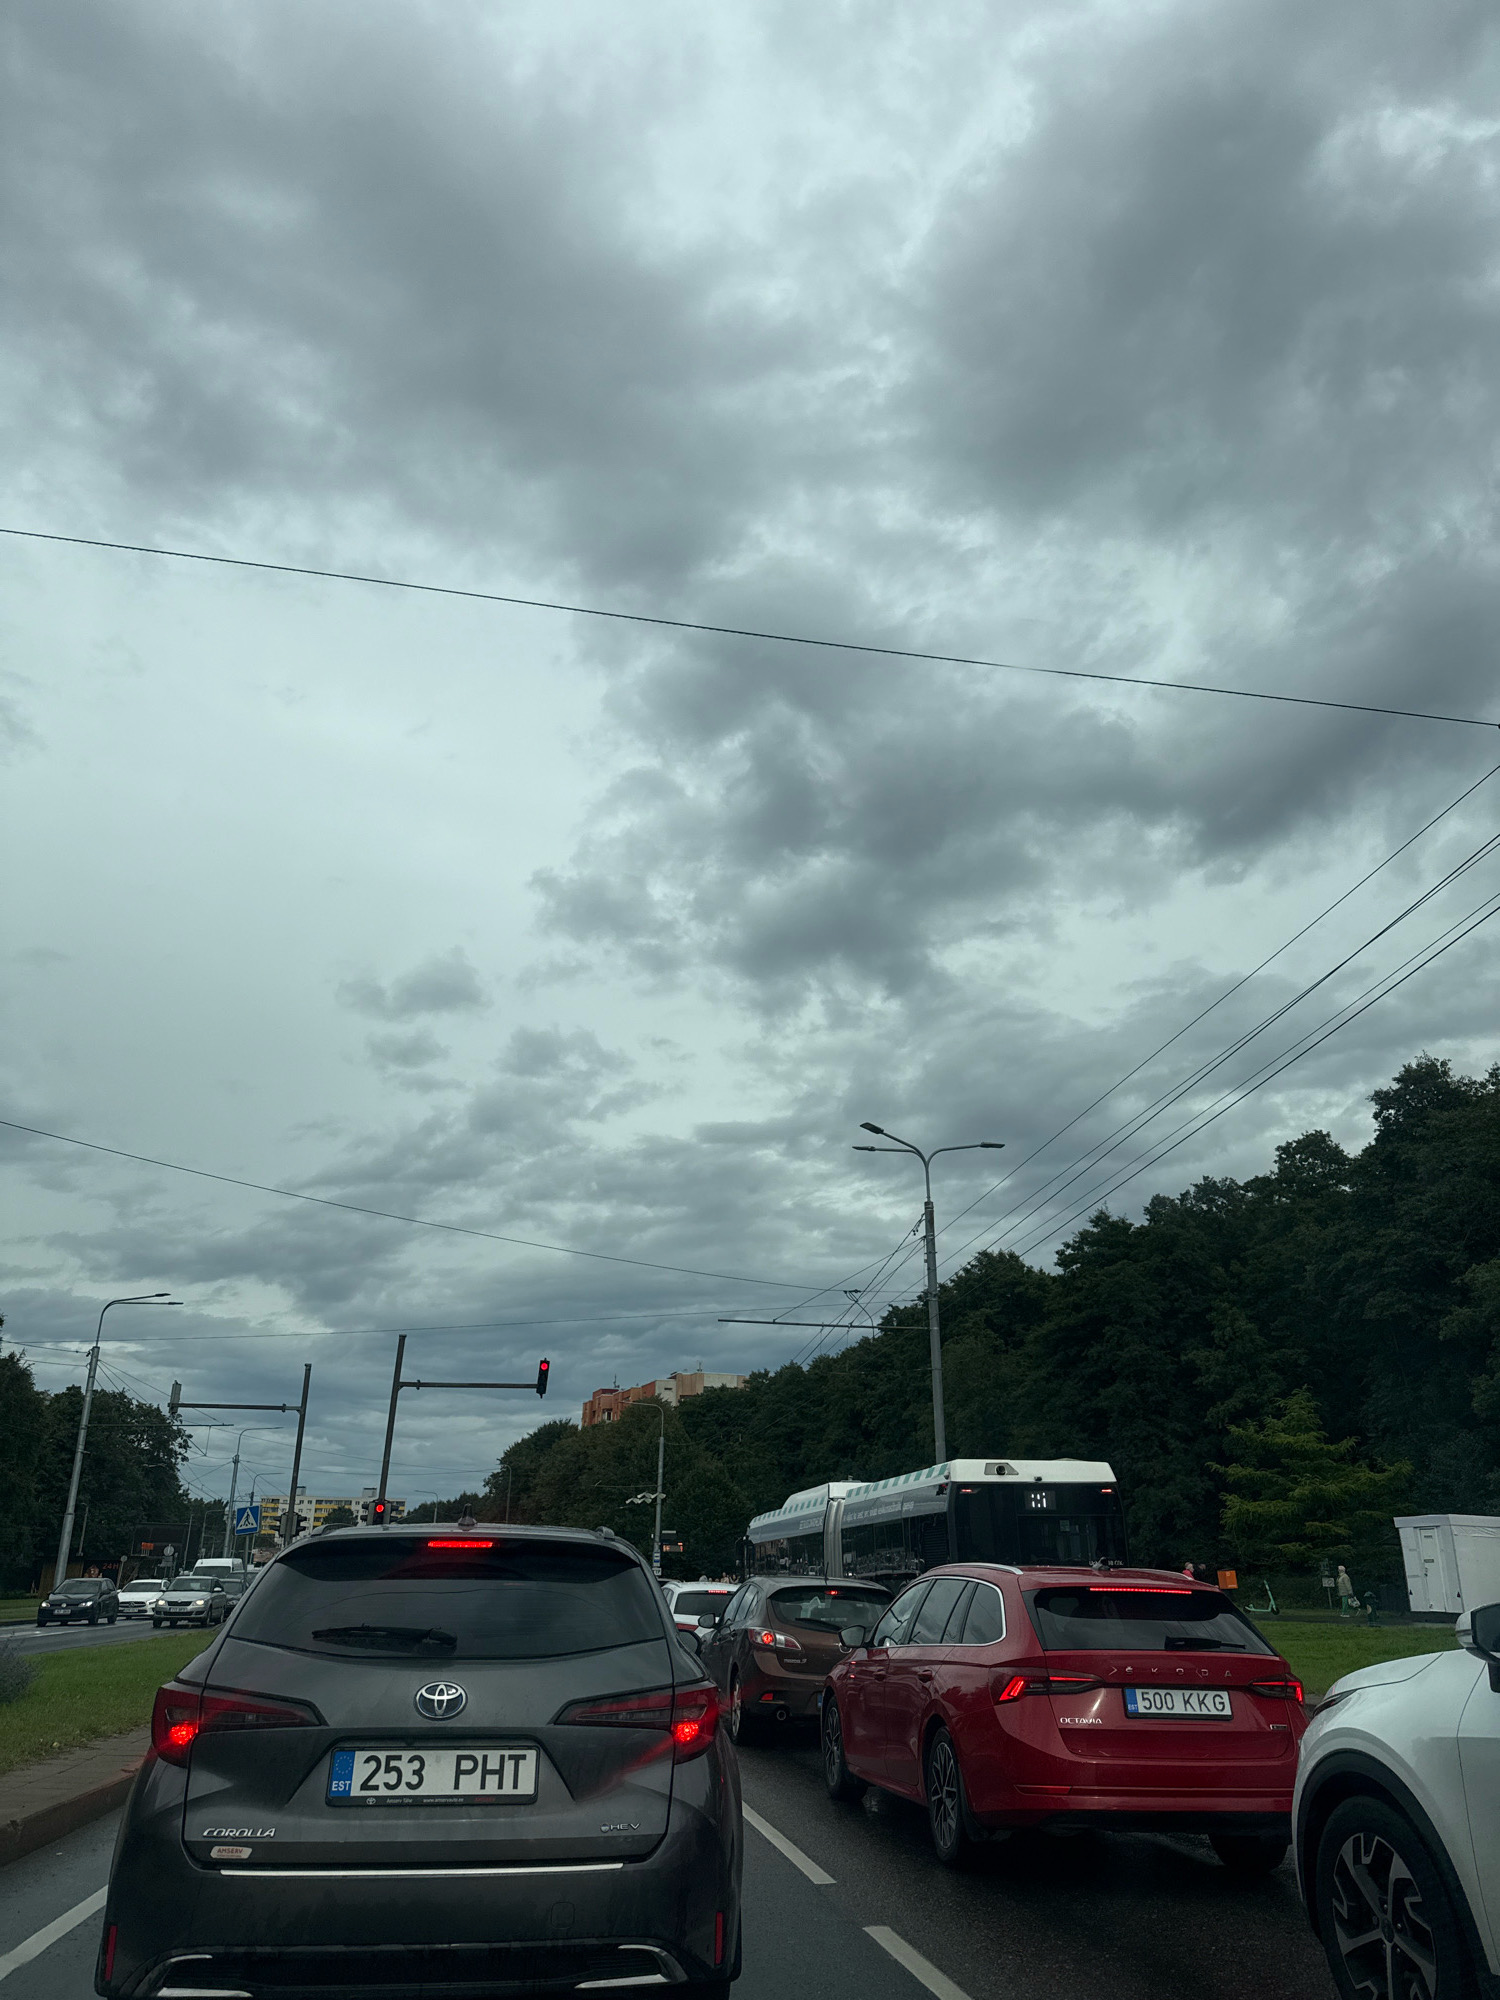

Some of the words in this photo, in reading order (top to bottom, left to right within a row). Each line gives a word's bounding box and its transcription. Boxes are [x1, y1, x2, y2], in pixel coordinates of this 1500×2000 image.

[1141, 1691, 1174, 1711] 500
[1183, 1692, 1226, 1713] KKG
[1060, 1717, 1103, 1725] OCTAVIA
[359, 1754, 426, 1792] 253
[453, 1754, 527, 1790] PHT
[331, 1780, 351, 1791] EST
[202, 1827, 276, 1838] COROLLA
[610, 1823, 640, 1831] HEV
